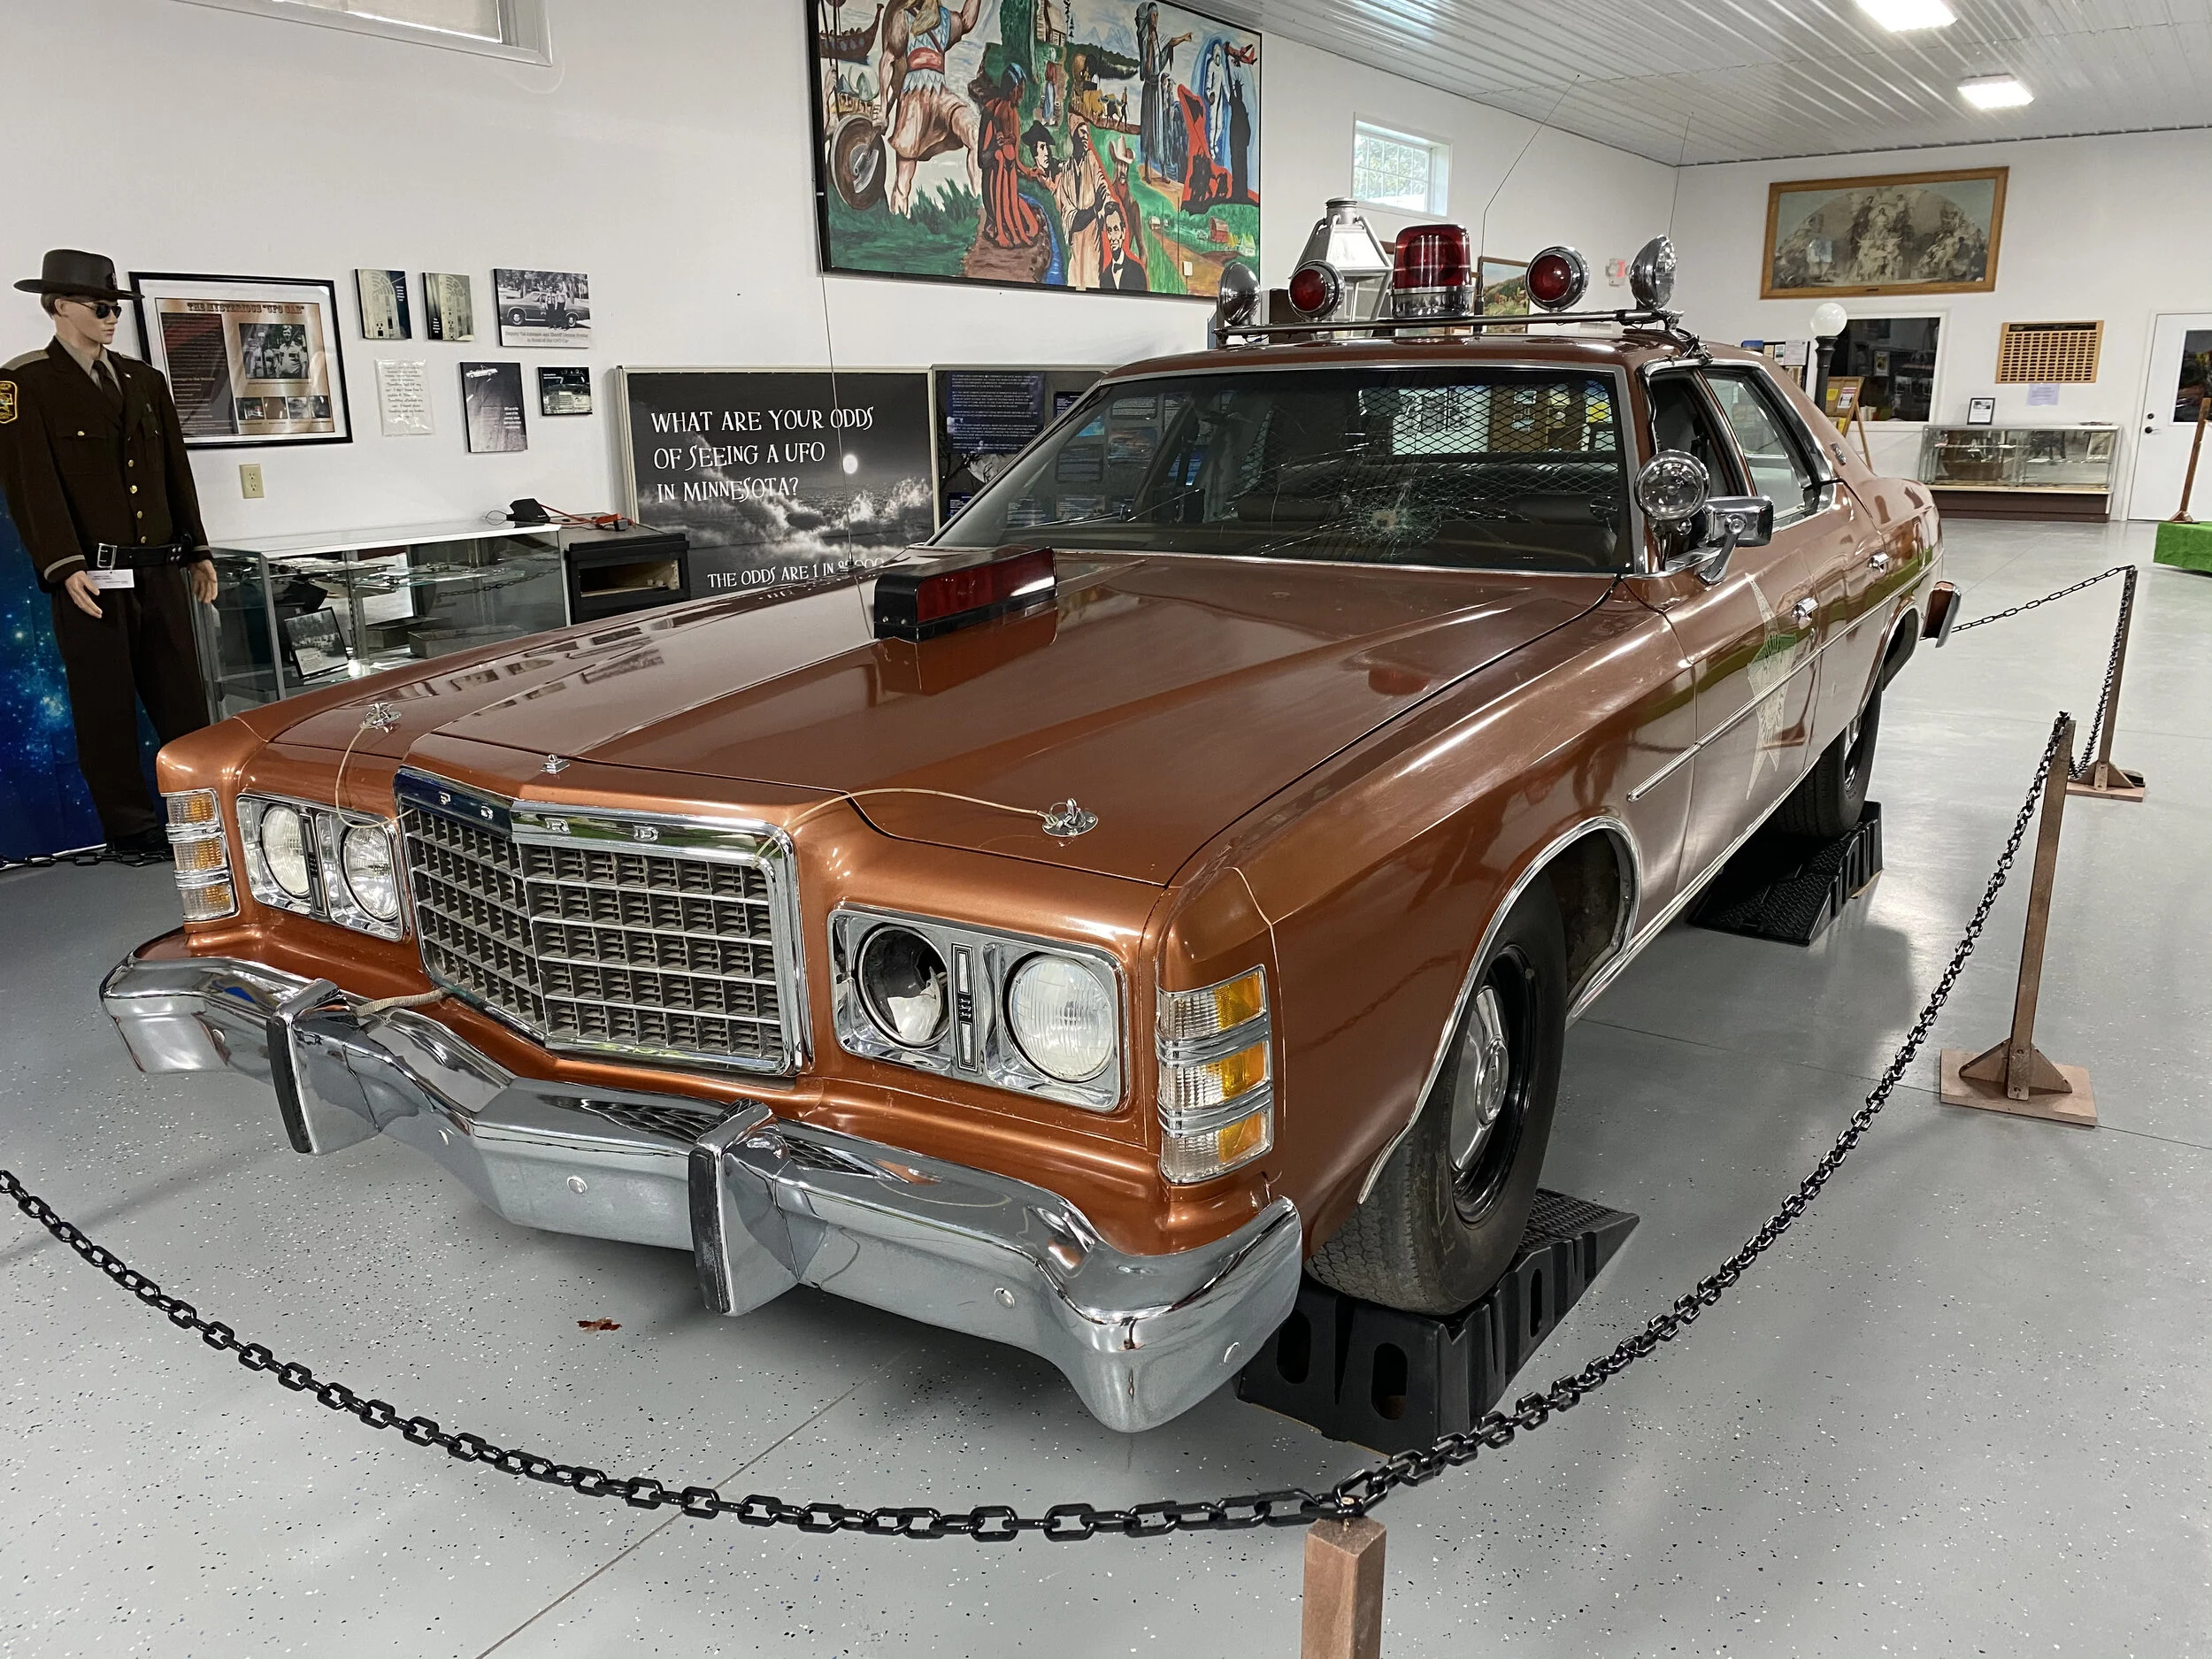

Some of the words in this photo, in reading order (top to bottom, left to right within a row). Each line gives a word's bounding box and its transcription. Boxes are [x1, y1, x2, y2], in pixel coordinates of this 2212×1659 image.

[187, 303, 205, 311] THE
[206, 303, 262, 313] MYSTERIOUS
[651, 411, 713, 434] WHAT
[721, 411, 762, 432] ARE
[768, 409, 825, 431] YOUR
[830, 406, 874, 431] ODDS
[654, 448, 682, 470] OF
[685, 444, 759, 471] SEEING
[766, 444, 780, 464] A
[785, 442, 826, 463] UFO
[657, 483, 675, 503] IN
[683, 477, 799, 503] MINNESOTA?
[708, 572, 737, 588] THE
[741, 565, 776, 585] ODDS
[781, 565, 809, 580] ARE
[812, 564, 818, 578] 1
[823, 562, 834, 576] IN
